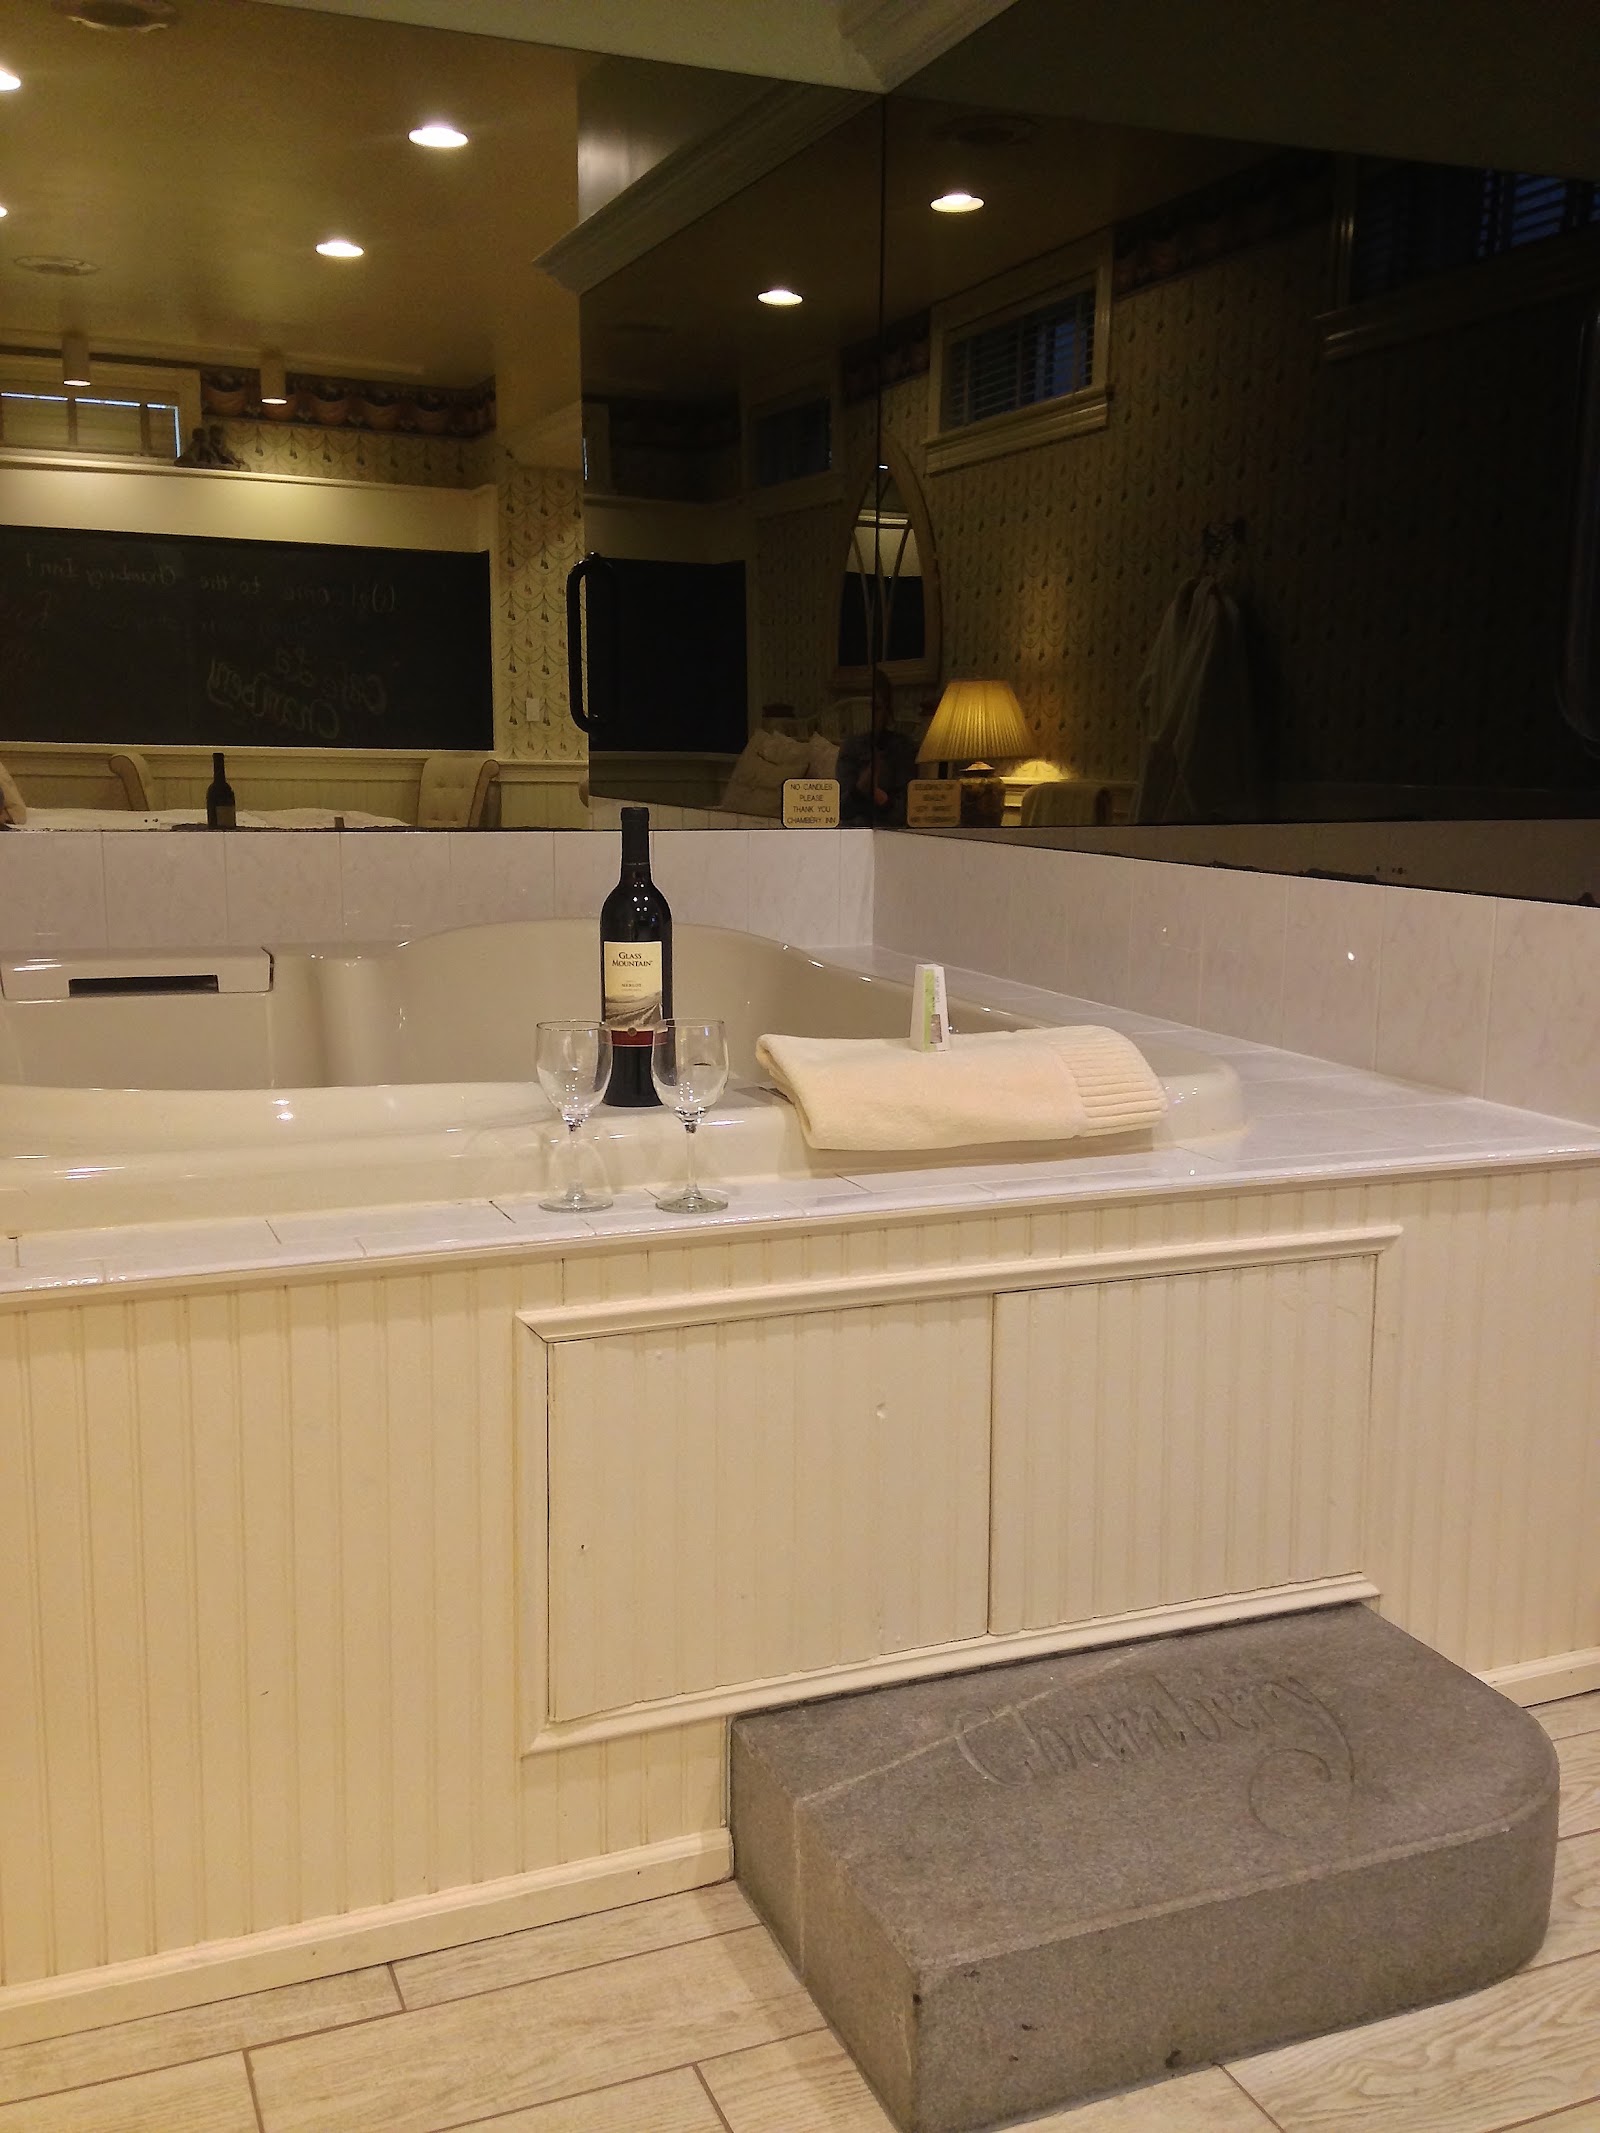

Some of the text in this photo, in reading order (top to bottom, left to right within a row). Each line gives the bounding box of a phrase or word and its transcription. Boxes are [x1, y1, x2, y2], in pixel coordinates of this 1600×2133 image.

[790, 783, 833, 791] NO CANDLES
[799, 794, 824, 802] PLEASE
[793, 805, 831, 813] THANK YOU
[825, 816, 836, 824] INN
[618, 951, 642, 960] GLASS
